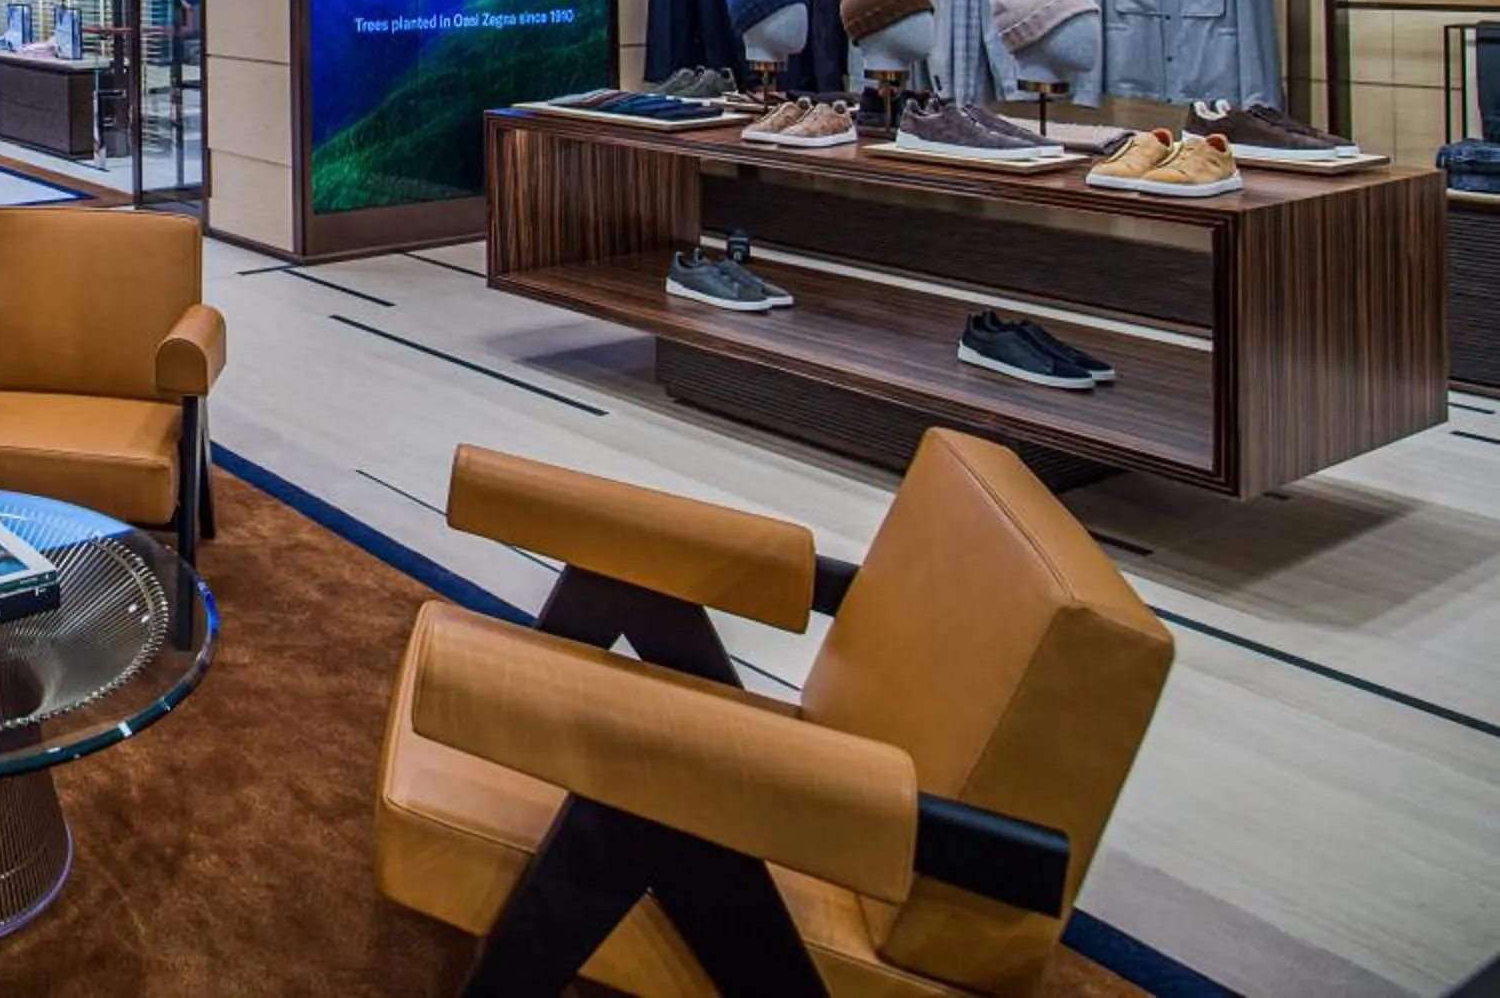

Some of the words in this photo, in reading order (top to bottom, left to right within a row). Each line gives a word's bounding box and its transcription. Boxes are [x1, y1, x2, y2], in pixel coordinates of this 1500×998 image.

[354, 17, 389, 33] Trees
[391, 14, 437, 34] planted
[439, 13, 451, 28] in
[453, 13, 479, 27] Oasi
[481, 12, 517, 29] Zegna
[519, 10, 547, 25] since
